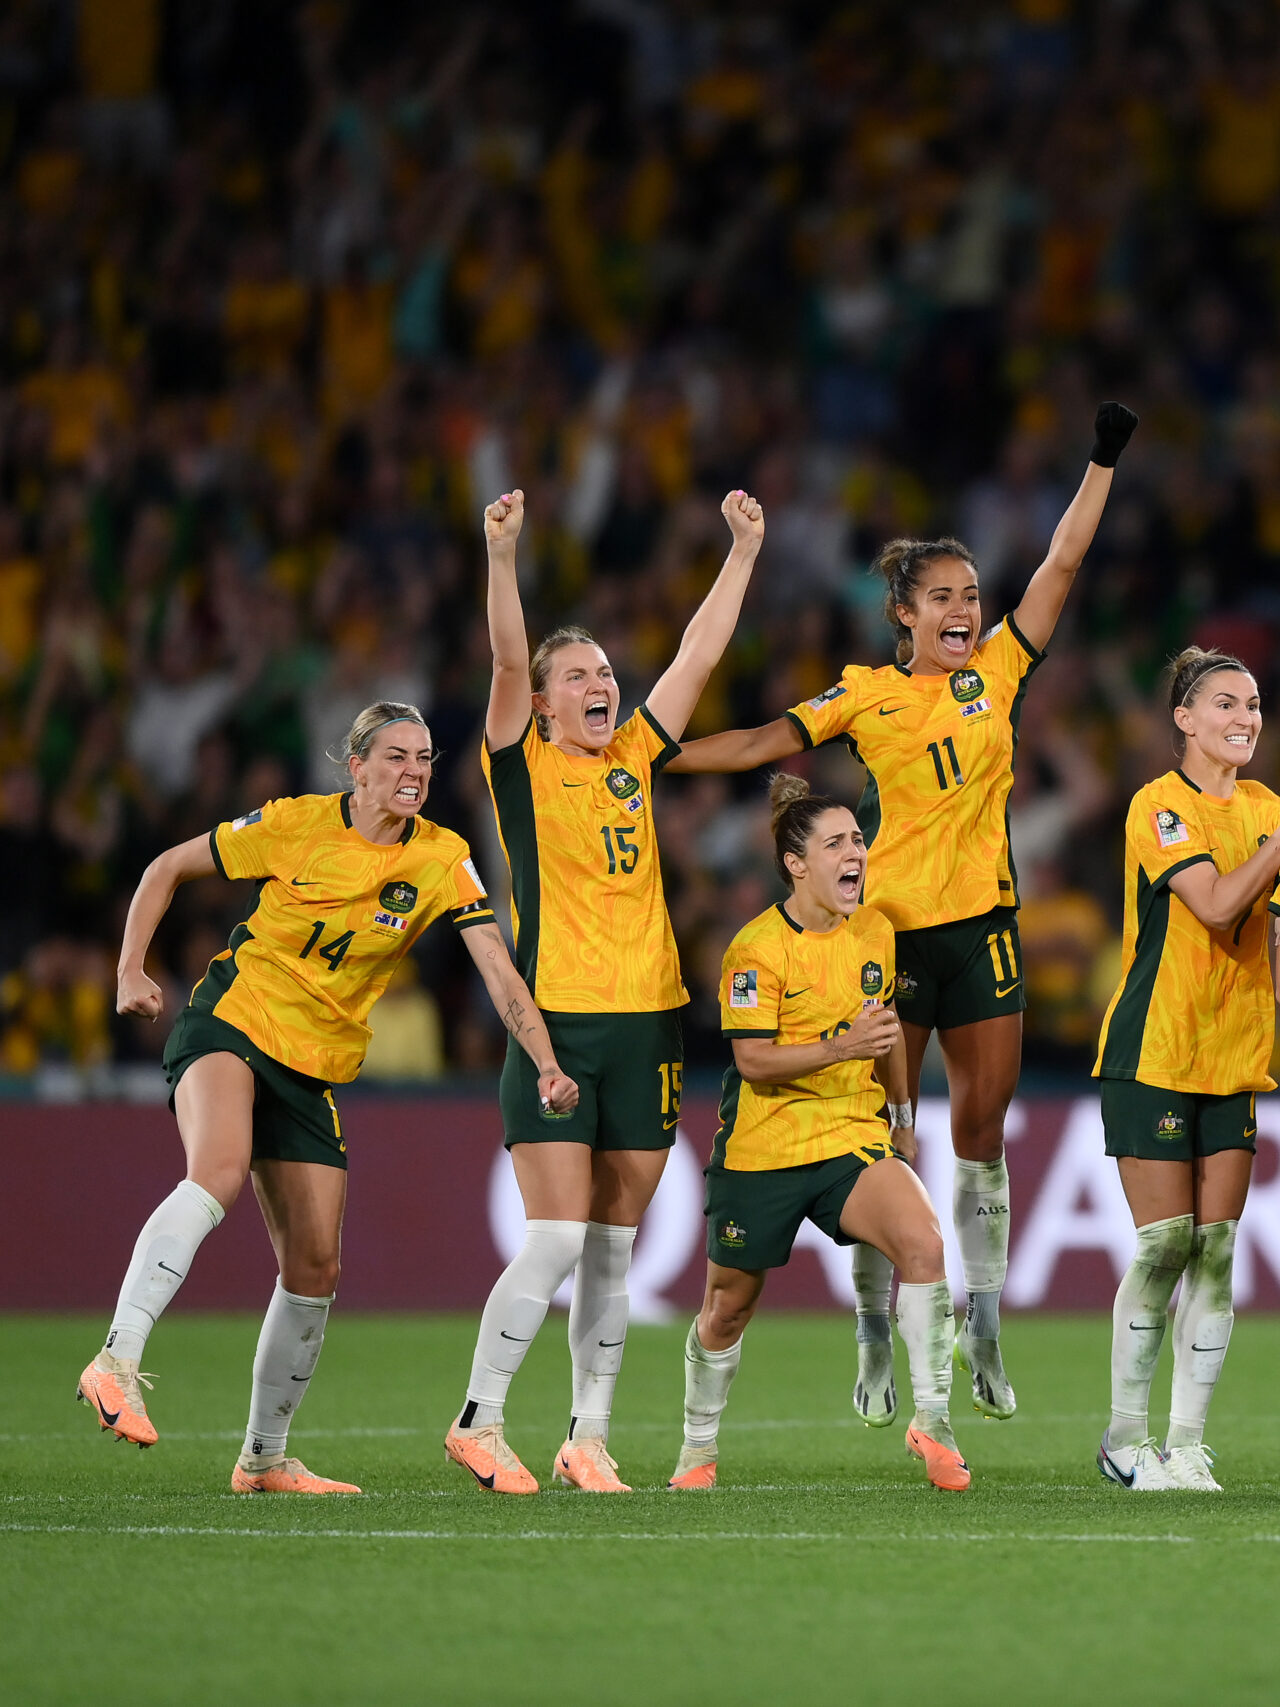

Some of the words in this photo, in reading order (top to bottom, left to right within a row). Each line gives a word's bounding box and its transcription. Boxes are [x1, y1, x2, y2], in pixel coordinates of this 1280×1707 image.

[926, 735, 963, 791] 11
[600, 825, 639, 875] 15
[298, 920, 357, 972] 14
[986, 928, 1018, 982] 11
[657, 1062, 684, 1114] 15
[976, 1205, 1009, 1216] AUS
